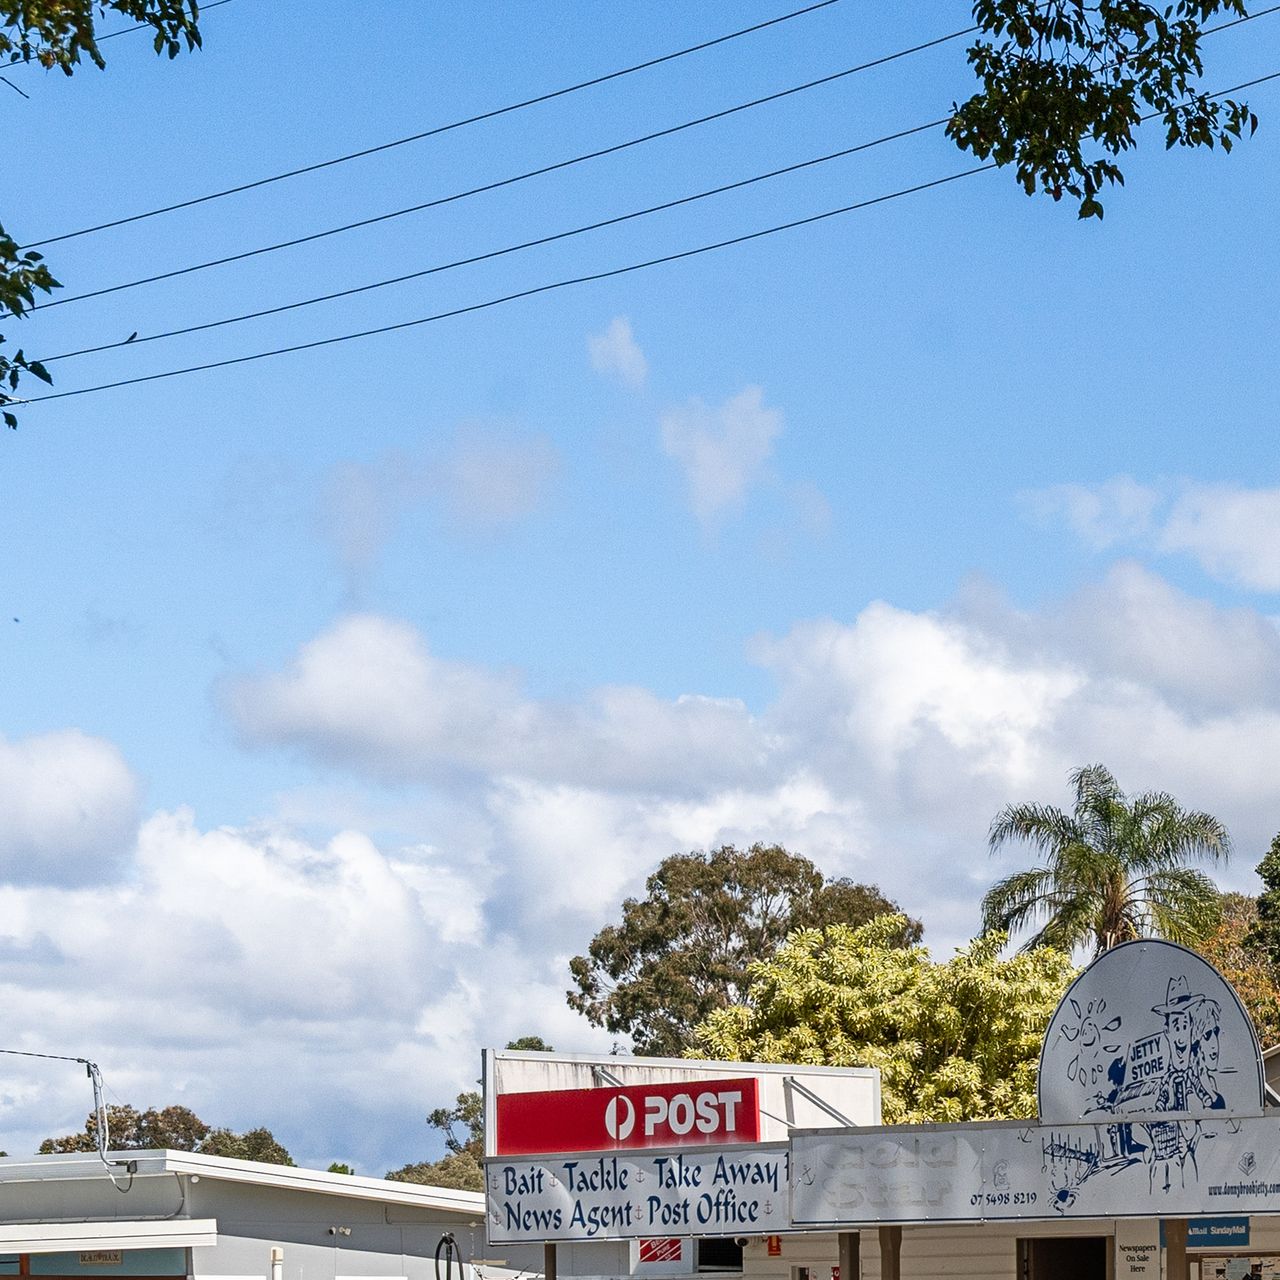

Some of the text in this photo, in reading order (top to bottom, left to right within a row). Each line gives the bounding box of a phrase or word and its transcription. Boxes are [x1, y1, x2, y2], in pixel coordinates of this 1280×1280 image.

[1130, 1036, 1161, 1062] JETTY
[1131, 1056, 1164, 1080] STORE
[644, 1091, 742, 1136] POST
[503, 1165, 544, 1196] Bait
[562, 1157, 629, 1192] Tackle
[653, 1153, 701, 1188] Take
[711, 1155, 779, 1192] Away
[970, 1191, 1037, 1206] 07 5498 8219
[503, 1188, 759, 1236] News Agent Post Office
[1119, 1244, 1157, 1253] Newspapers
[1136, 1254, 1150, 1262] Sale
